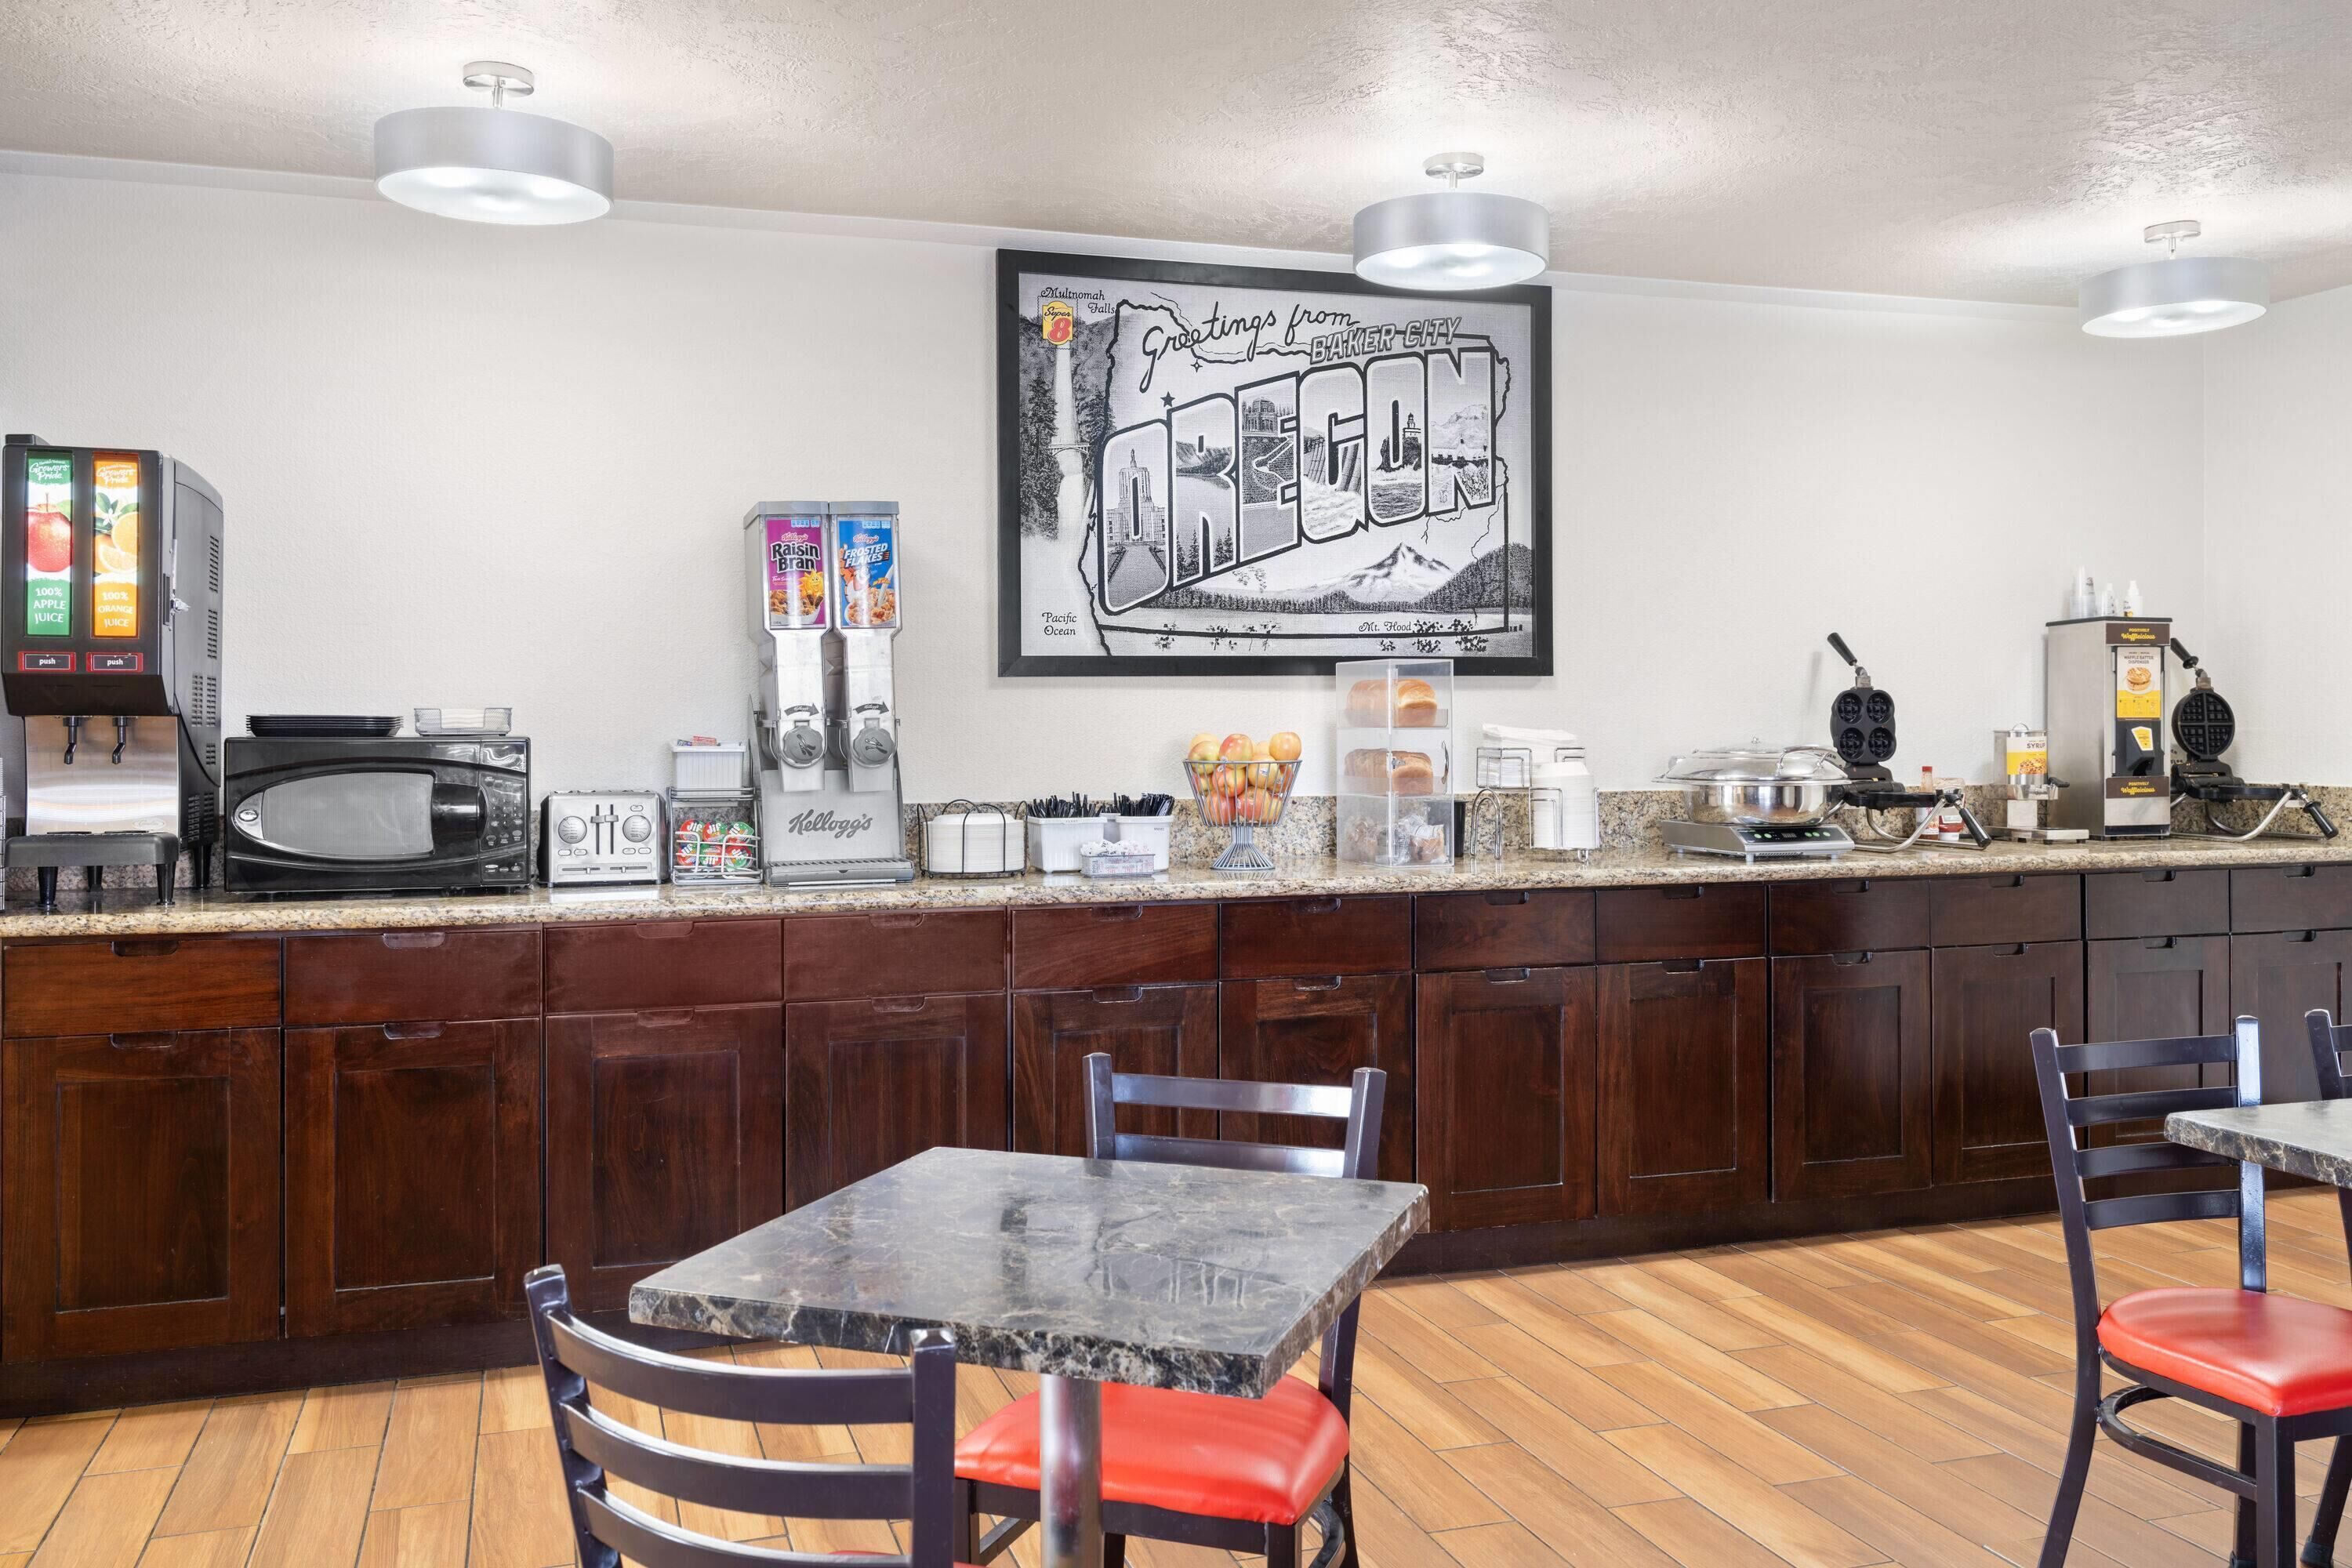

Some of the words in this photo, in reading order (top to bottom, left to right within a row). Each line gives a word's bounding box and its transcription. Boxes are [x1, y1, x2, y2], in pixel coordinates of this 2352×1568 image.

[1040, 287, 1105, 300] Multnomah
[1044, 307, 1071, 321] Super
[1087, 303, 1115, 314] Falls
[1047, 318, 1072, 343] 8
[1309, 322, 1396, 365] BAKER
[1403, 317, 1462, 347] CITY
[1139, 301, 1276, 393] Greetings
[1285, 303, 1360, 346] from
[36, 470, 63, 481] Pride
[1098, 346, 1497, 615] OREGON
[782, 532, 808, 543] Kellogg's
[853, 533, 879, 543] Kellogg's
[771, 542, 820, 560] Raisin
[844, 543, 888, 560] FROSTED
[778, 557, 815, 572] Bran
[845, 552, 884, 568] FLAKES
[35, 586, 63, 597] 100%
[102, 591, 129, 601] 100%
[33, 599, 66, 610] APPLE
[97, 605, 134, 615] ORANGE
[34, 612, 64, 624] JUICE
[103, 618, 129, 628] JUICE
[1042, 612, 1077, 624] Pacific
[1044, 625, 1076, 635] Ocean
[1358, 622, 1380, 632] Mt.
[1384, 622, 1411, 631] Hood
[39, 657, 56, 666] push
[107, 658, 123, 666] push
[687, 822, 702, 832] Jif
[707, 822, 721, 834] Jif
[789, 809, 873, 838] Kellogg's
